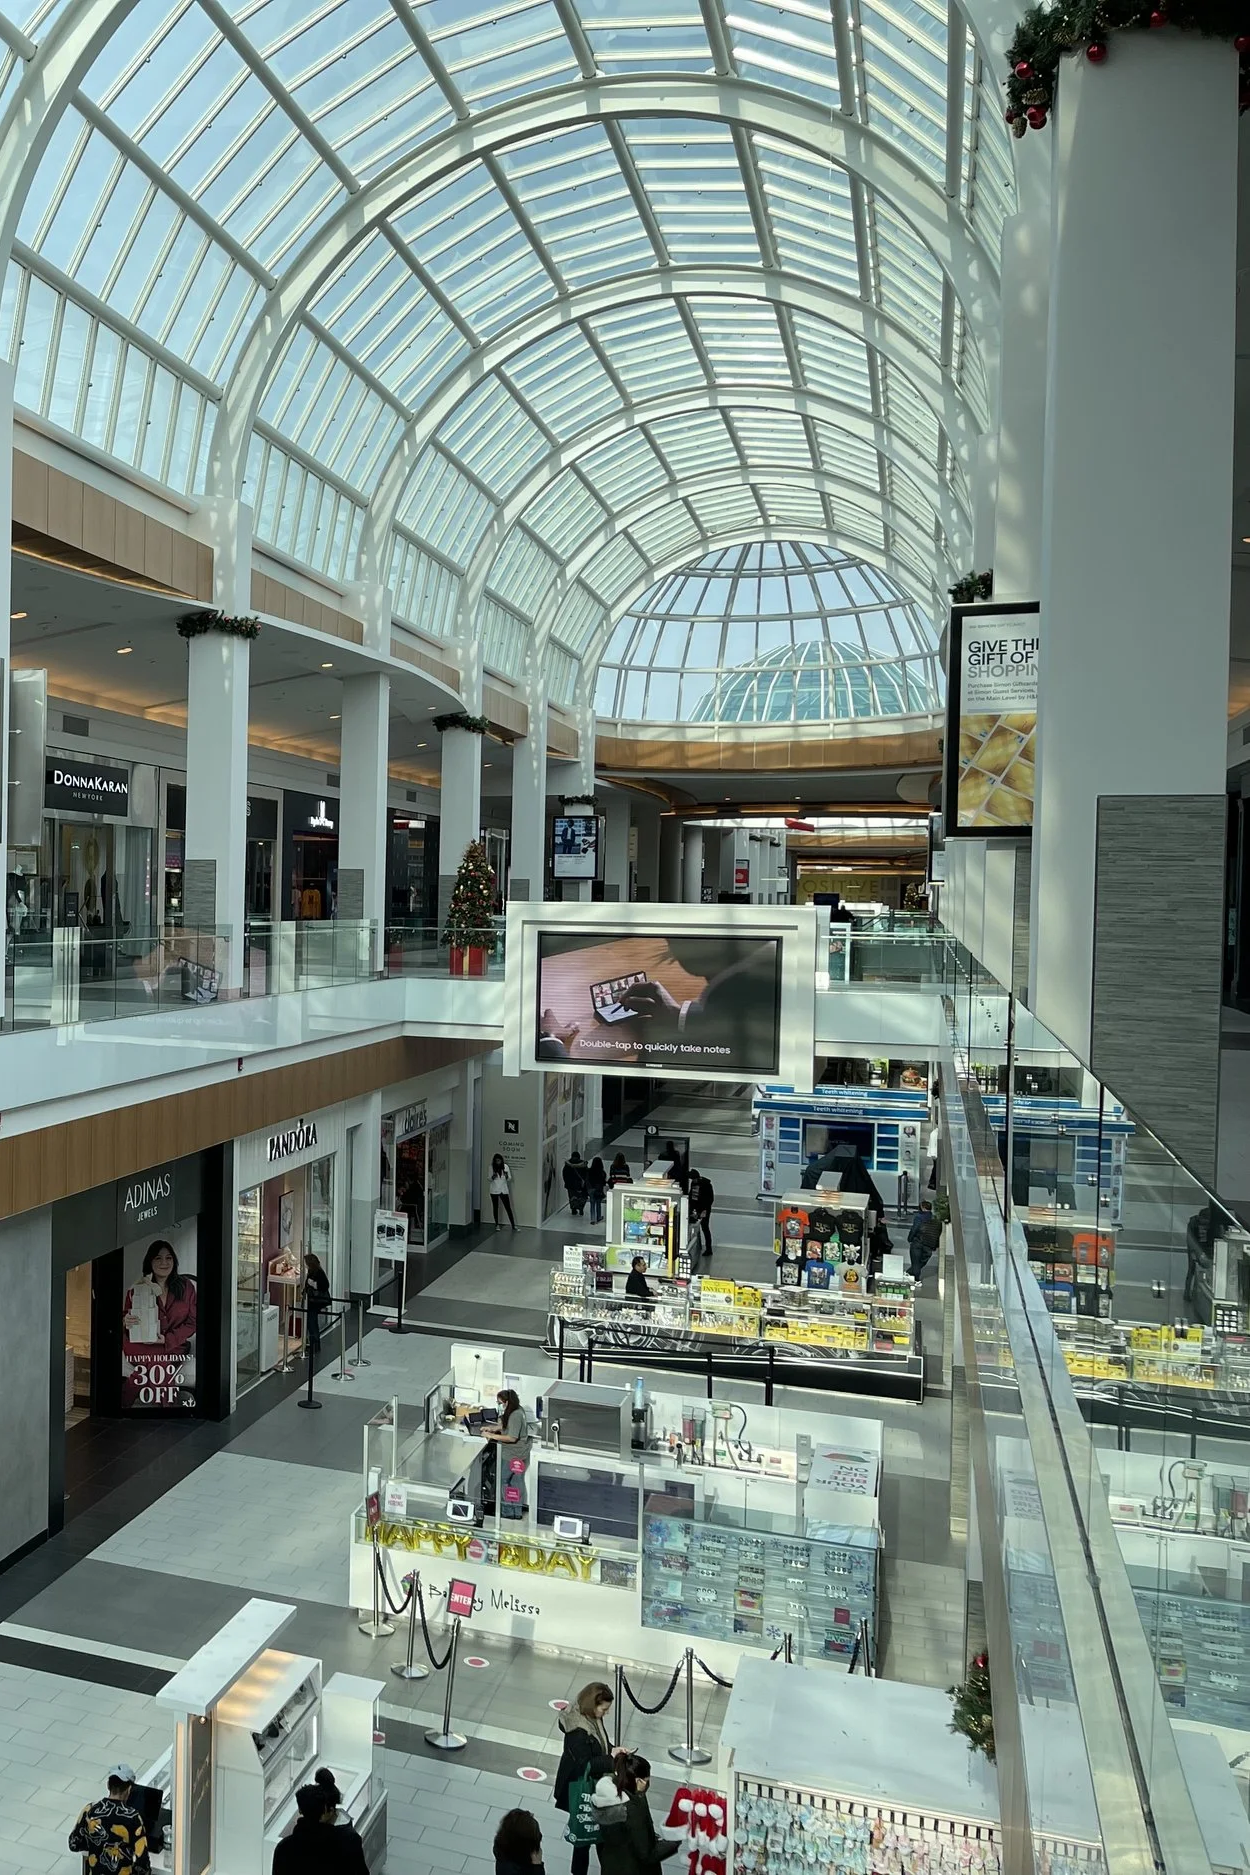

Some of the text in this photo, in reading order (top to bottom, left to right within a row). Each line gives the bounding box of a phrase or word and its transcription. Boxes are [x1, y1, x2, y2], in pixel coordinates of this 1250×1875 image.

[968, 640, 1008, 653] GIVE
[968, 651, 1034, 666] GIFT OF
[579, 1039, 731, 1055] Double-tap to quickly take notes
[839, 1089, 869, 1098] whitening
[831, 1107, 864, 1115] whitening
[267, 1119, 318, 1162] PANDORA
[124, 1173, 171, 1212] ADINAS
[137, 1206, 158, 1222] JEWELS
[702, 1285, 732, 1294] INVICTA
[126, 1354, 194, 1363] HAPPY HOLIDAYS!
[133, 1364, 185, 1386] 30%
[139, 1386, 180, 1404] OFF
[450, 1592, 472, 1606] ENTER
[491, 1588, 541, 1616] Melissa
